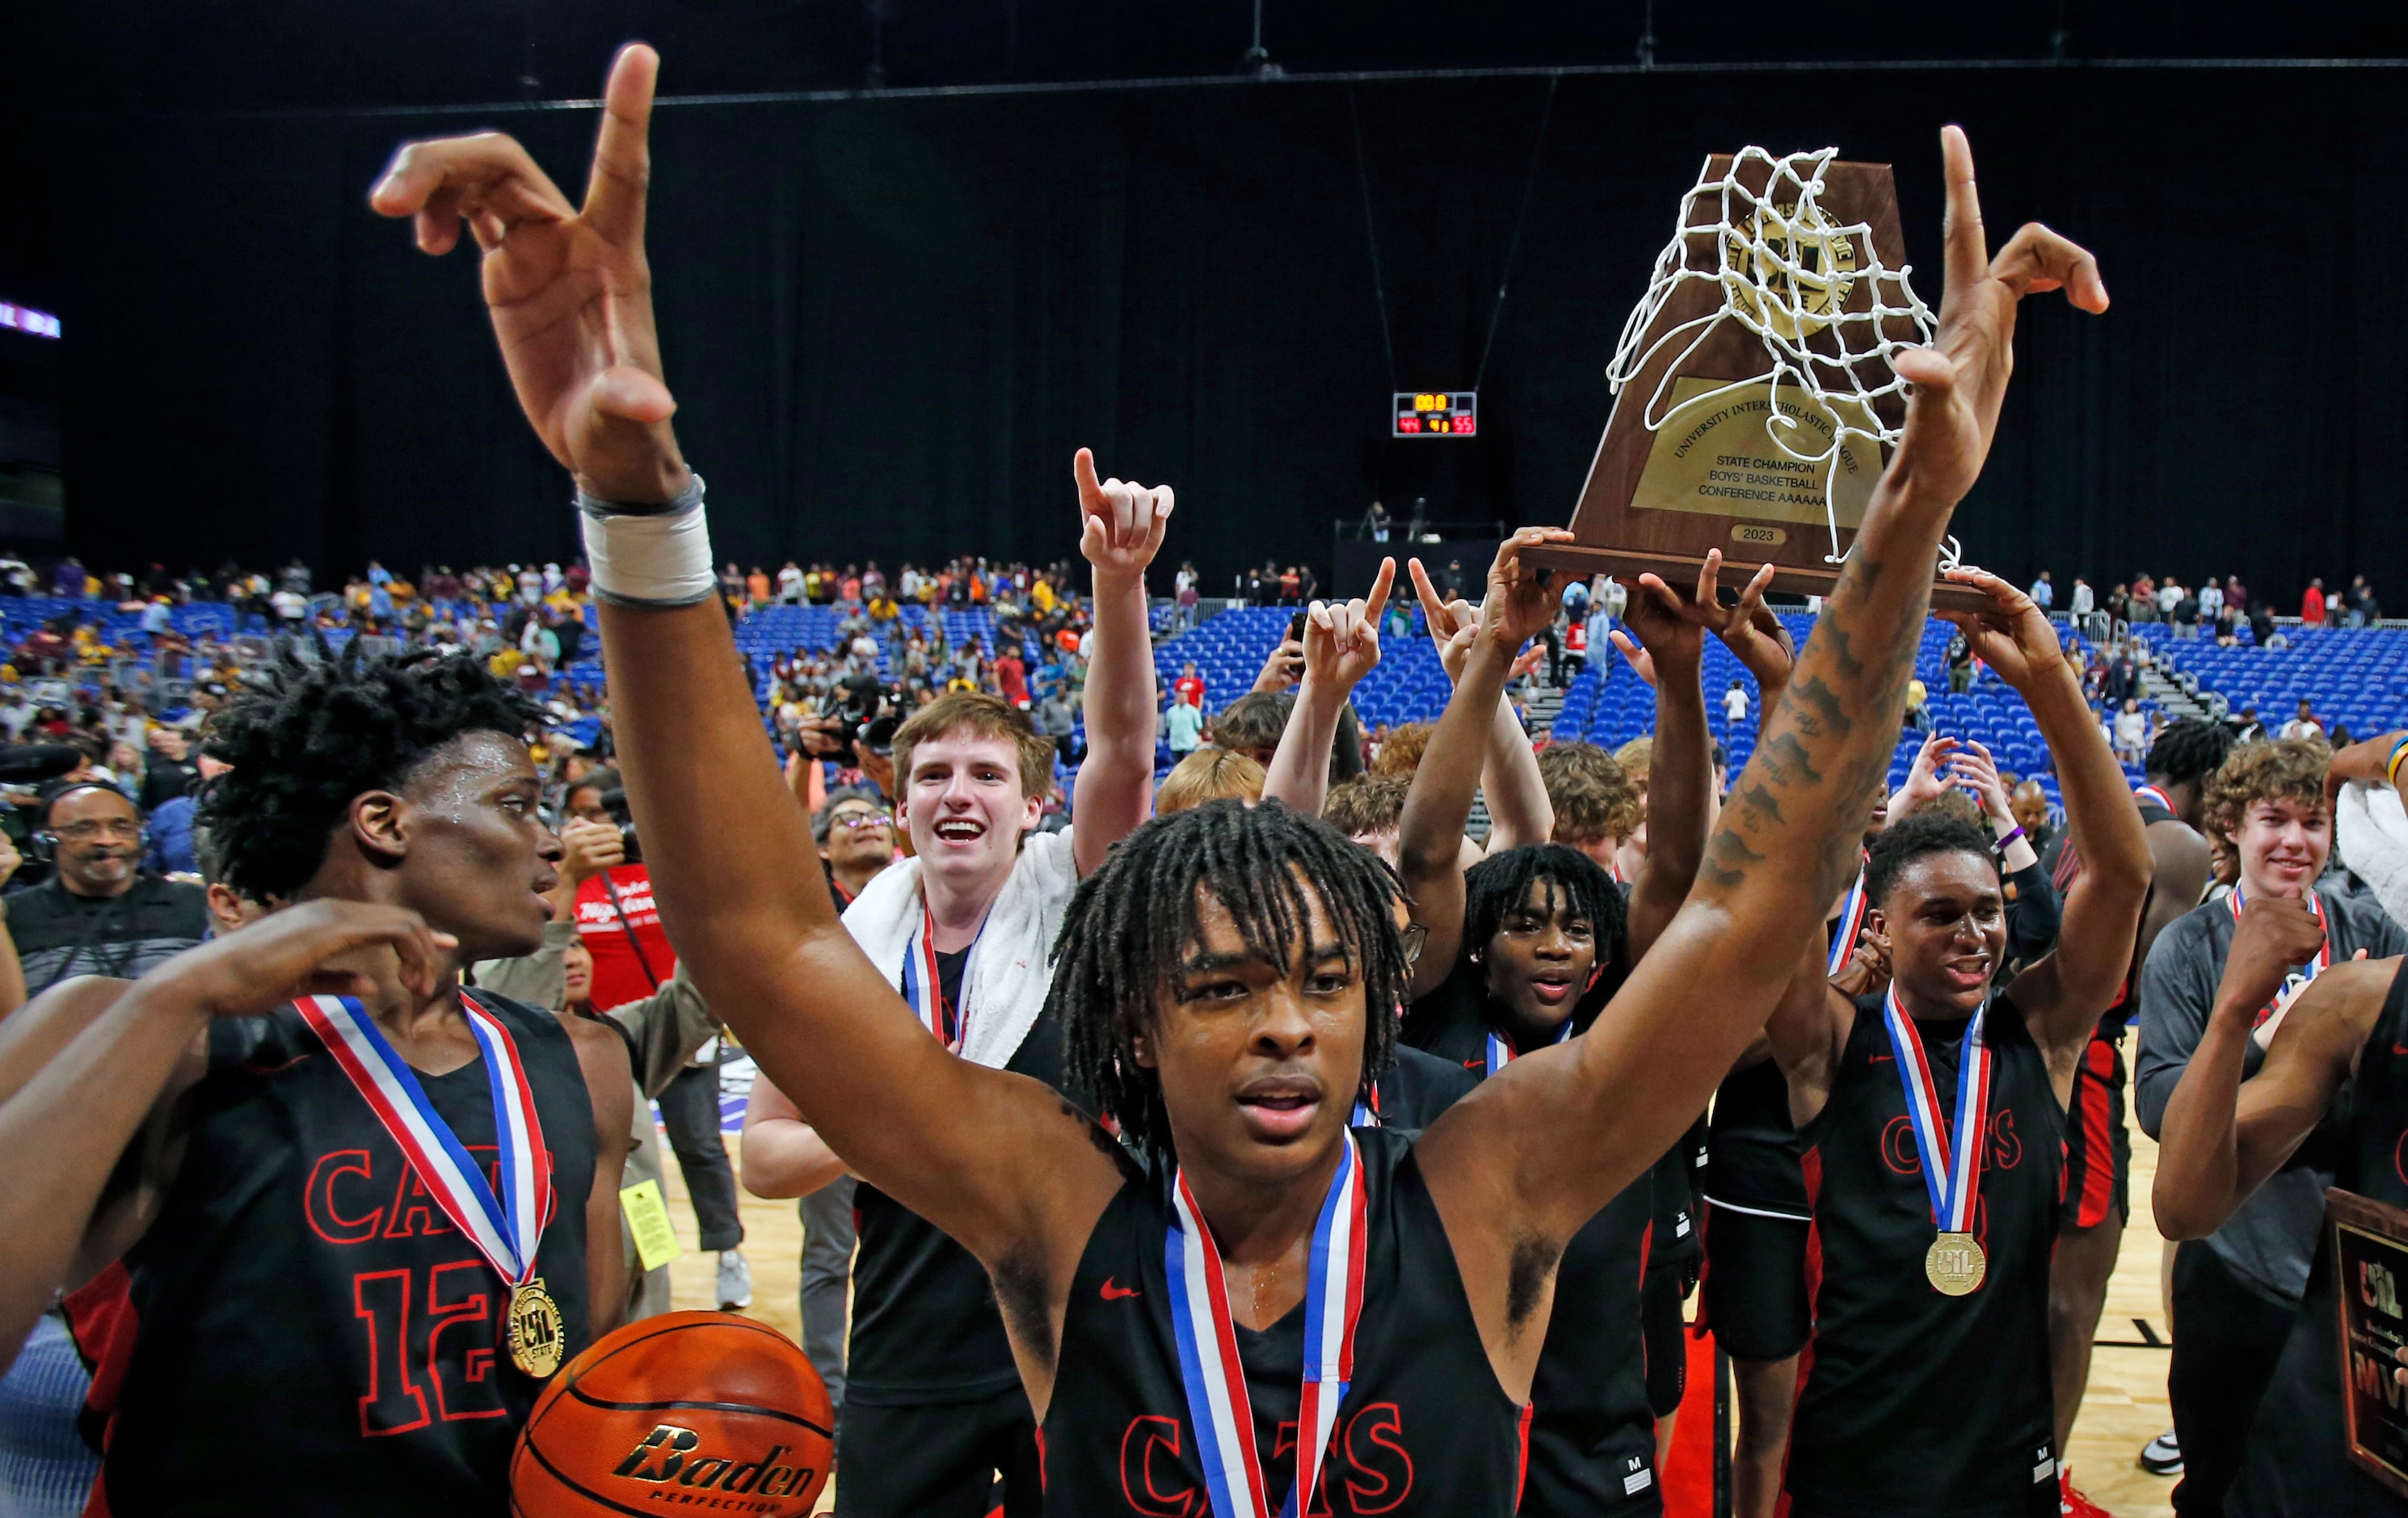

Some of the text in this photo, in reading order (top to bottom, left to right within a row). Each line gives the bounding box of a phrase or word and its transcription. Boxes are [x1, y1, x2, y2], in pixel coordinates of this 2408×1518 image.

[1673, 409, 1729, 460] UNIVERSITY
[1716, 455, 1815, 474] STATE CHAMPION
[1710, 470, 1818, 490] BOYS' BASKETBALL
[1699, 484, 1775, 502] CONFERENCE
[1743, 528, 1774, 542] 2023
[1937, 1250, 1974, 1274] UIL
[520, 1305, 555, 1348] UIL
[353, 1259, 507, 1438] 12
[533, 1344, 553, 1359] STATE
[2355, 1351, 2408, 1416] MV
[613, 1424, 815, 1497] Baden
[1627, 1456, 1642, 1471] M
[2037, 1446, 2048, 1461] M
